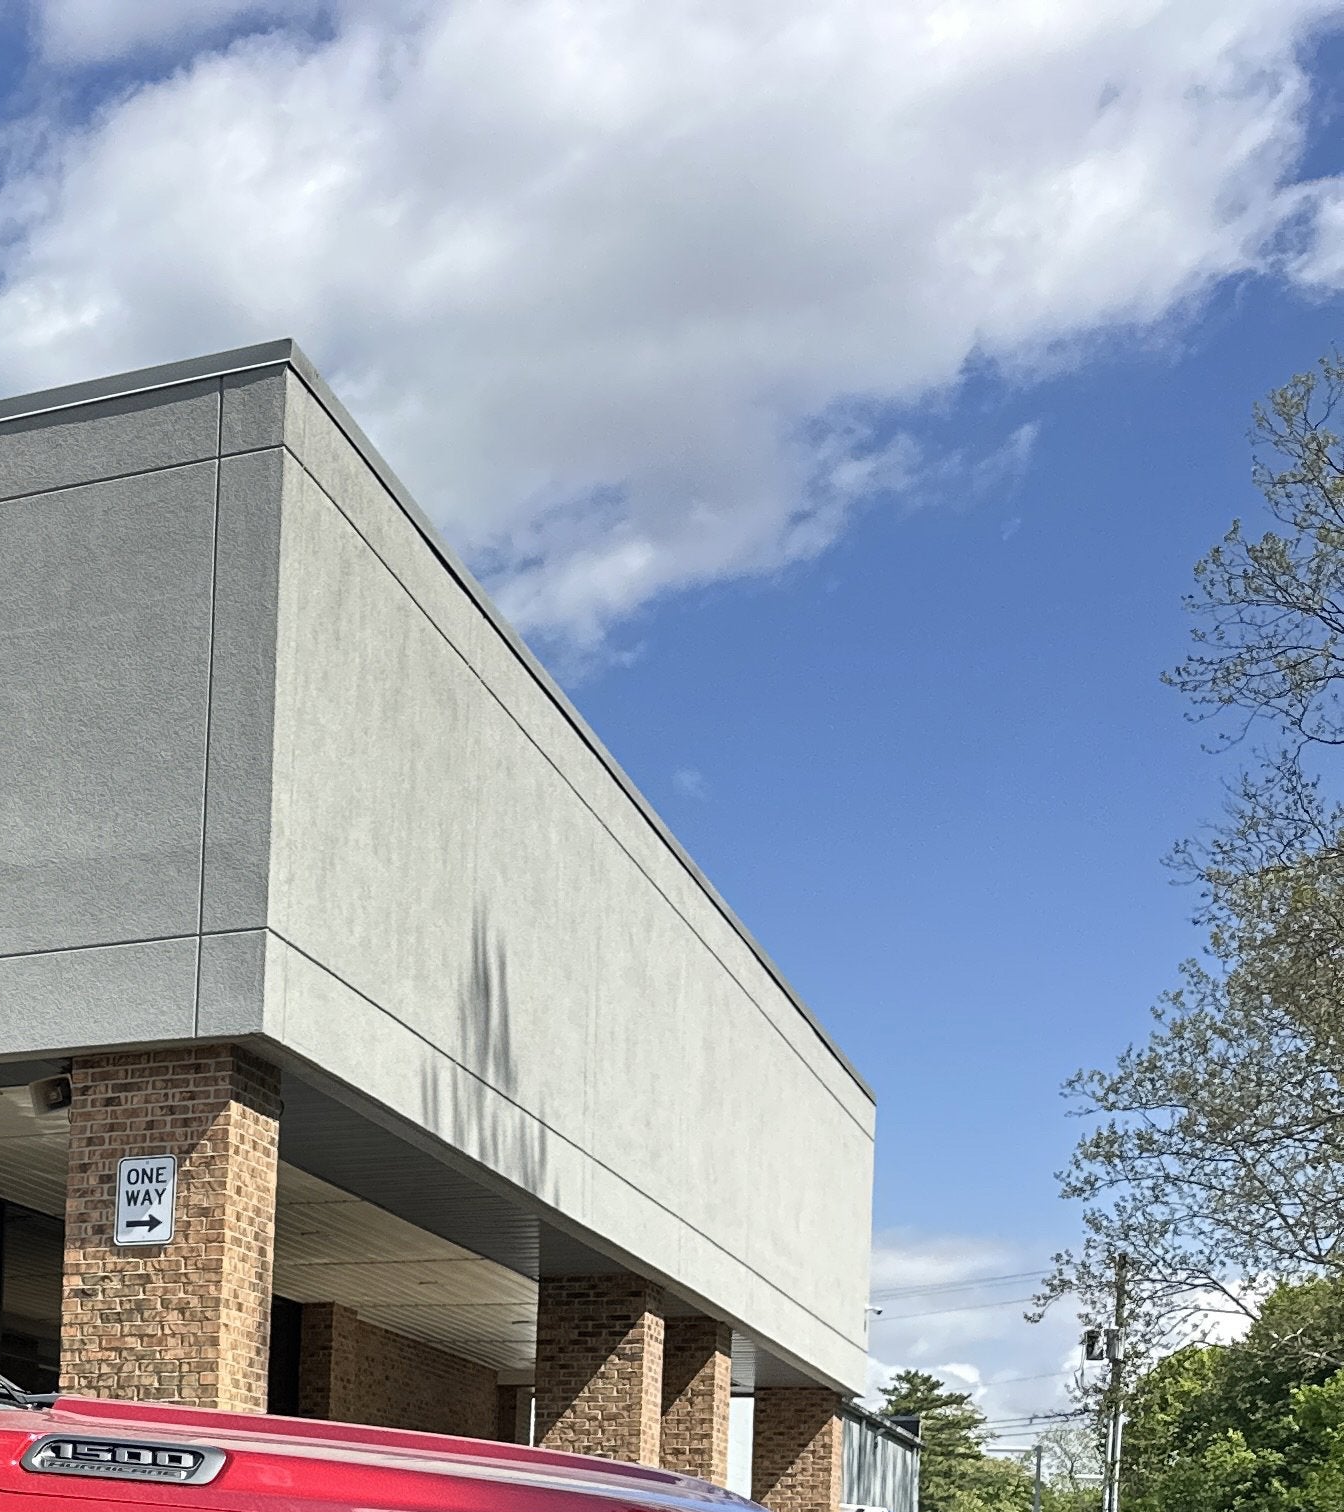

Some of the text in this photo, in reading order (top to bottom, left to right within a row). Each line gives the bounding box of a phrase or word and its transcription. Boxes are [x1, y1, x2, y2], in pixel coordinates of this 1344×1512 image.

[126, 1166, 168, 1186] ONE
[125, 1187, 167, 1207] WAY
[49, 1442, 194, 1469] 1500
